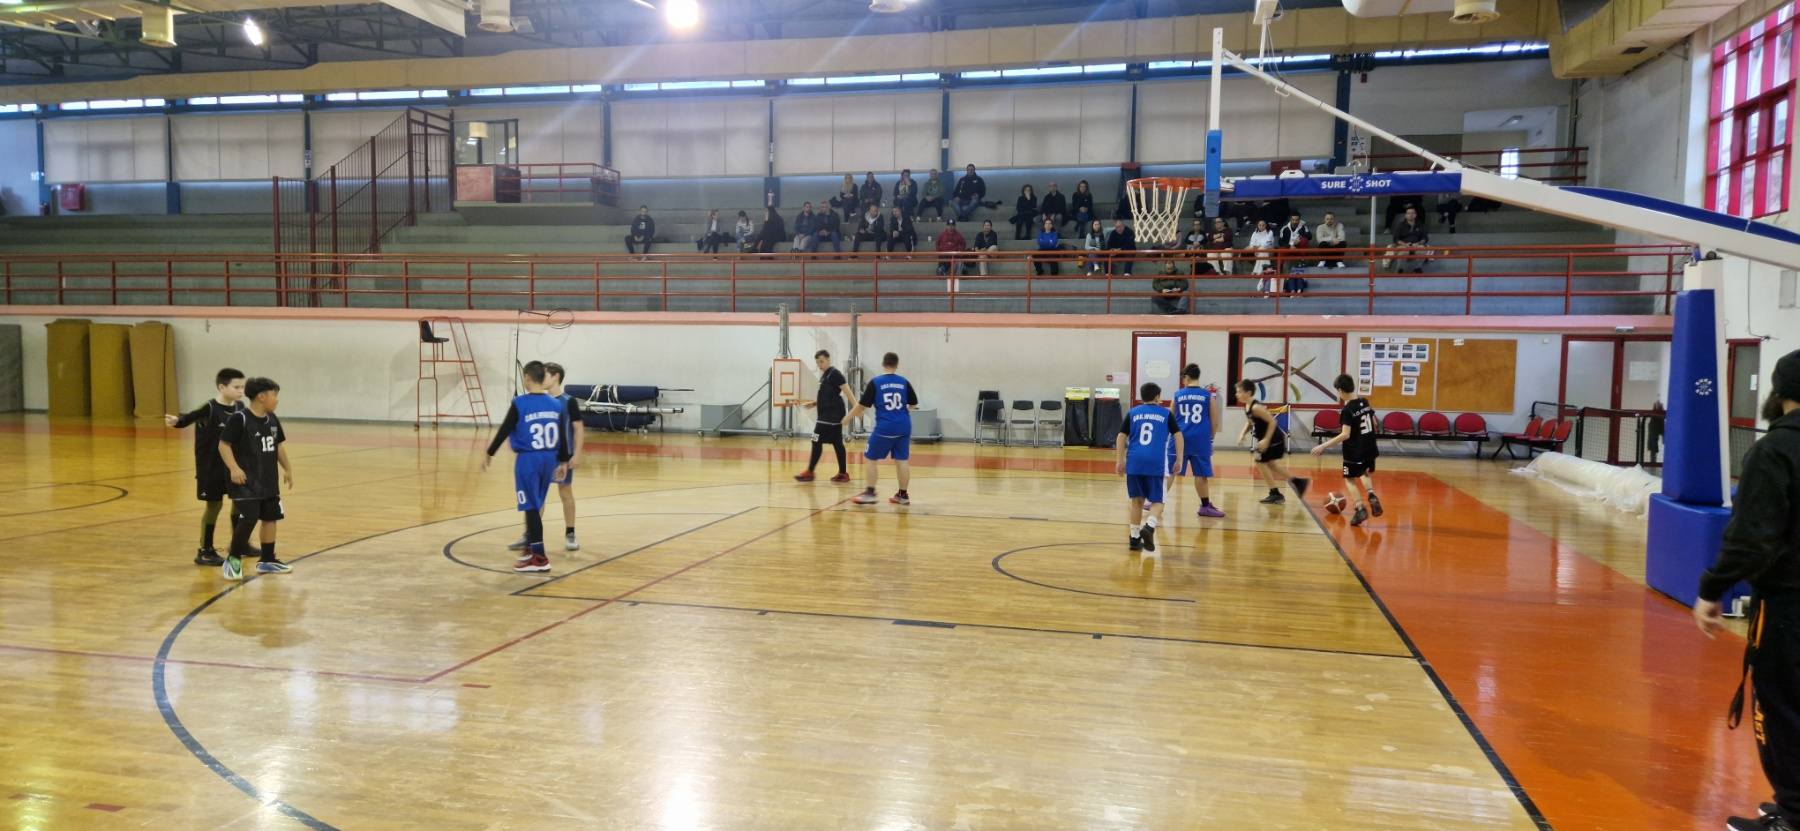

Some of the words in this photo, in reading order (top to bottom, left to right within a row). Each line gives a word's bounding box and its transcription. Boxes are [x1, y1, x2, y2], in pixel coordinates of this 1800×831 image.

[1321, 181, 1346, 190] SURE
[1365, 179, 1392, 188] SHOT
[883, 392, 903, 411] 50
[1180, 404, 1203, 424] 48
[1359, 413, 1373, 435] 31
[261, 436, 275, 452] 12
[530, 422, 559, 450] 30
[1139, 422, 1153, 446] 6
